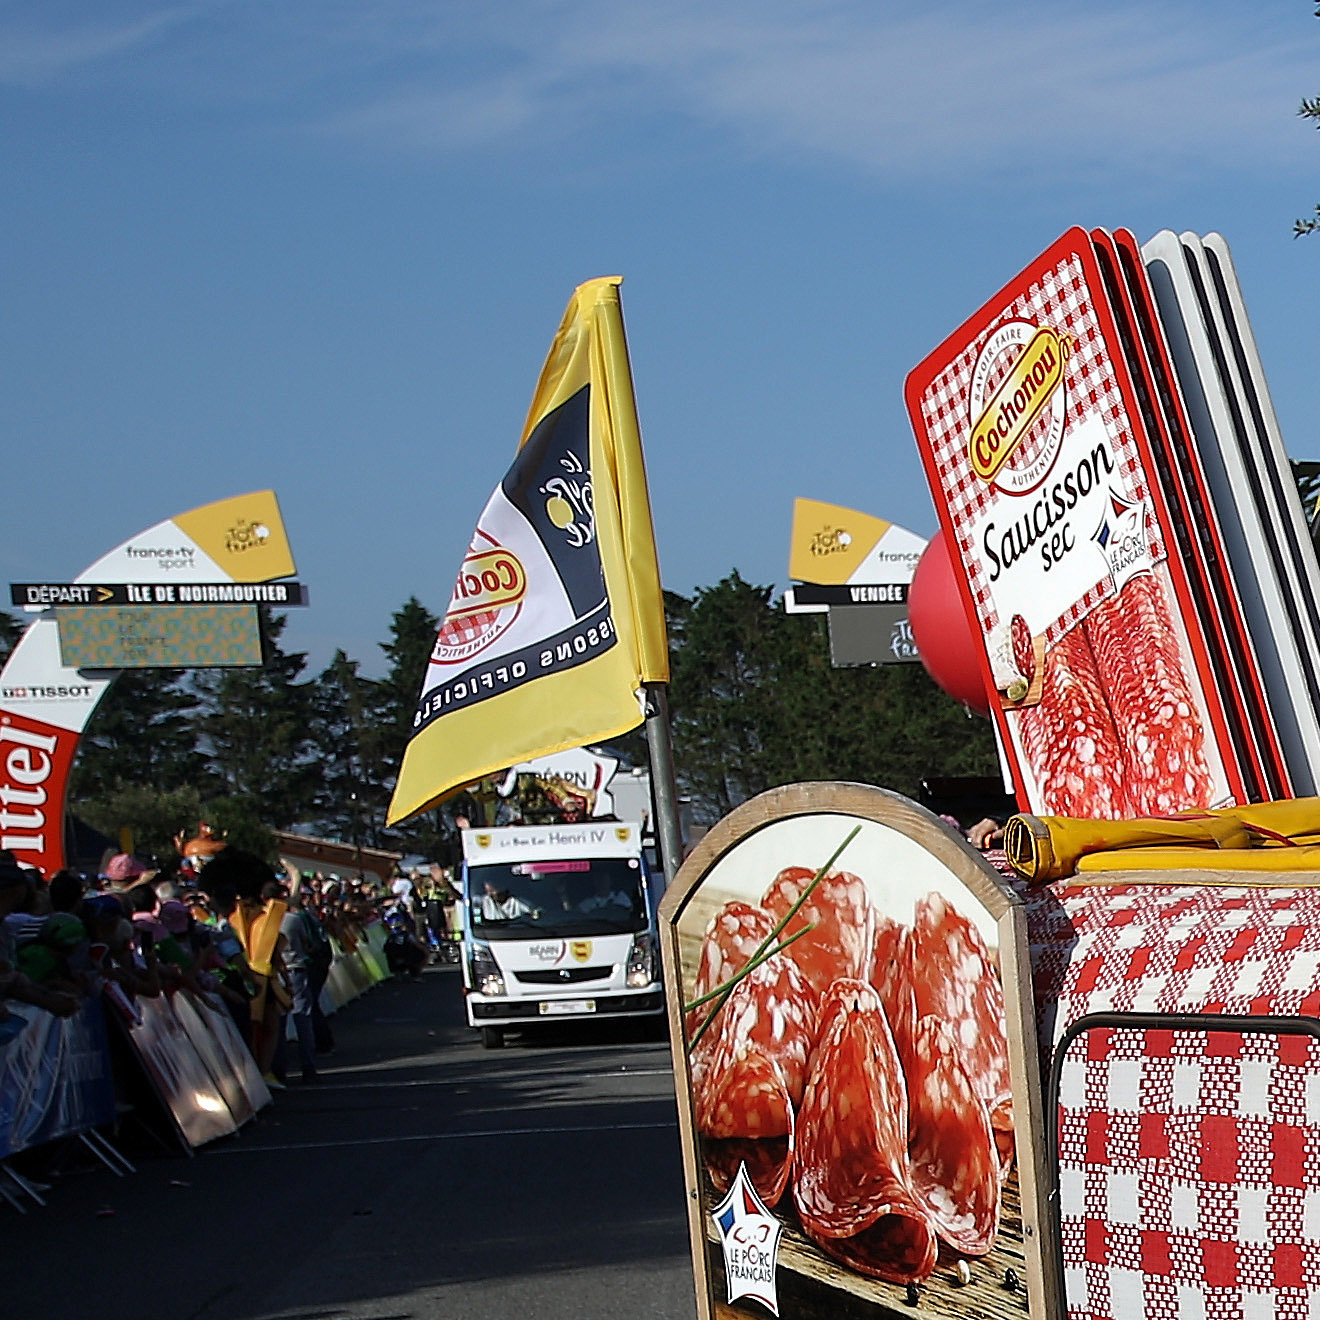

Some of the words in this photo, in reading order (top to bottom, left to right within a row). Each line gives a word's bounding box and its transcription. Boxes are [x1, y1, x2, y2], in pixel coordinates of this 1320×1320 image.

[974, 343, 1058, 468] Cochonou
[984, 442, 1115, 582] Saucisson
[1040, 521, 1075, 572] sec
[26, 585, 92, 603] DÉPART
[127, 584, 152, 602] ÎLE
[155, 586, 175, 602] DE
[179, 585, 287, 602] NOIRMOUTIER
[850, 585, 904, 602] VENDÉE
[31, 685, 93, 698] TISSOT
[0, 724, 58, 874] ittel
[550, 832, 587, 847] Henri
[730, 1247, 740, 1263] LE
[742, 1244, 770, 1268] PORC
[730, 1264, 773, 1284] FRANÇAIS
